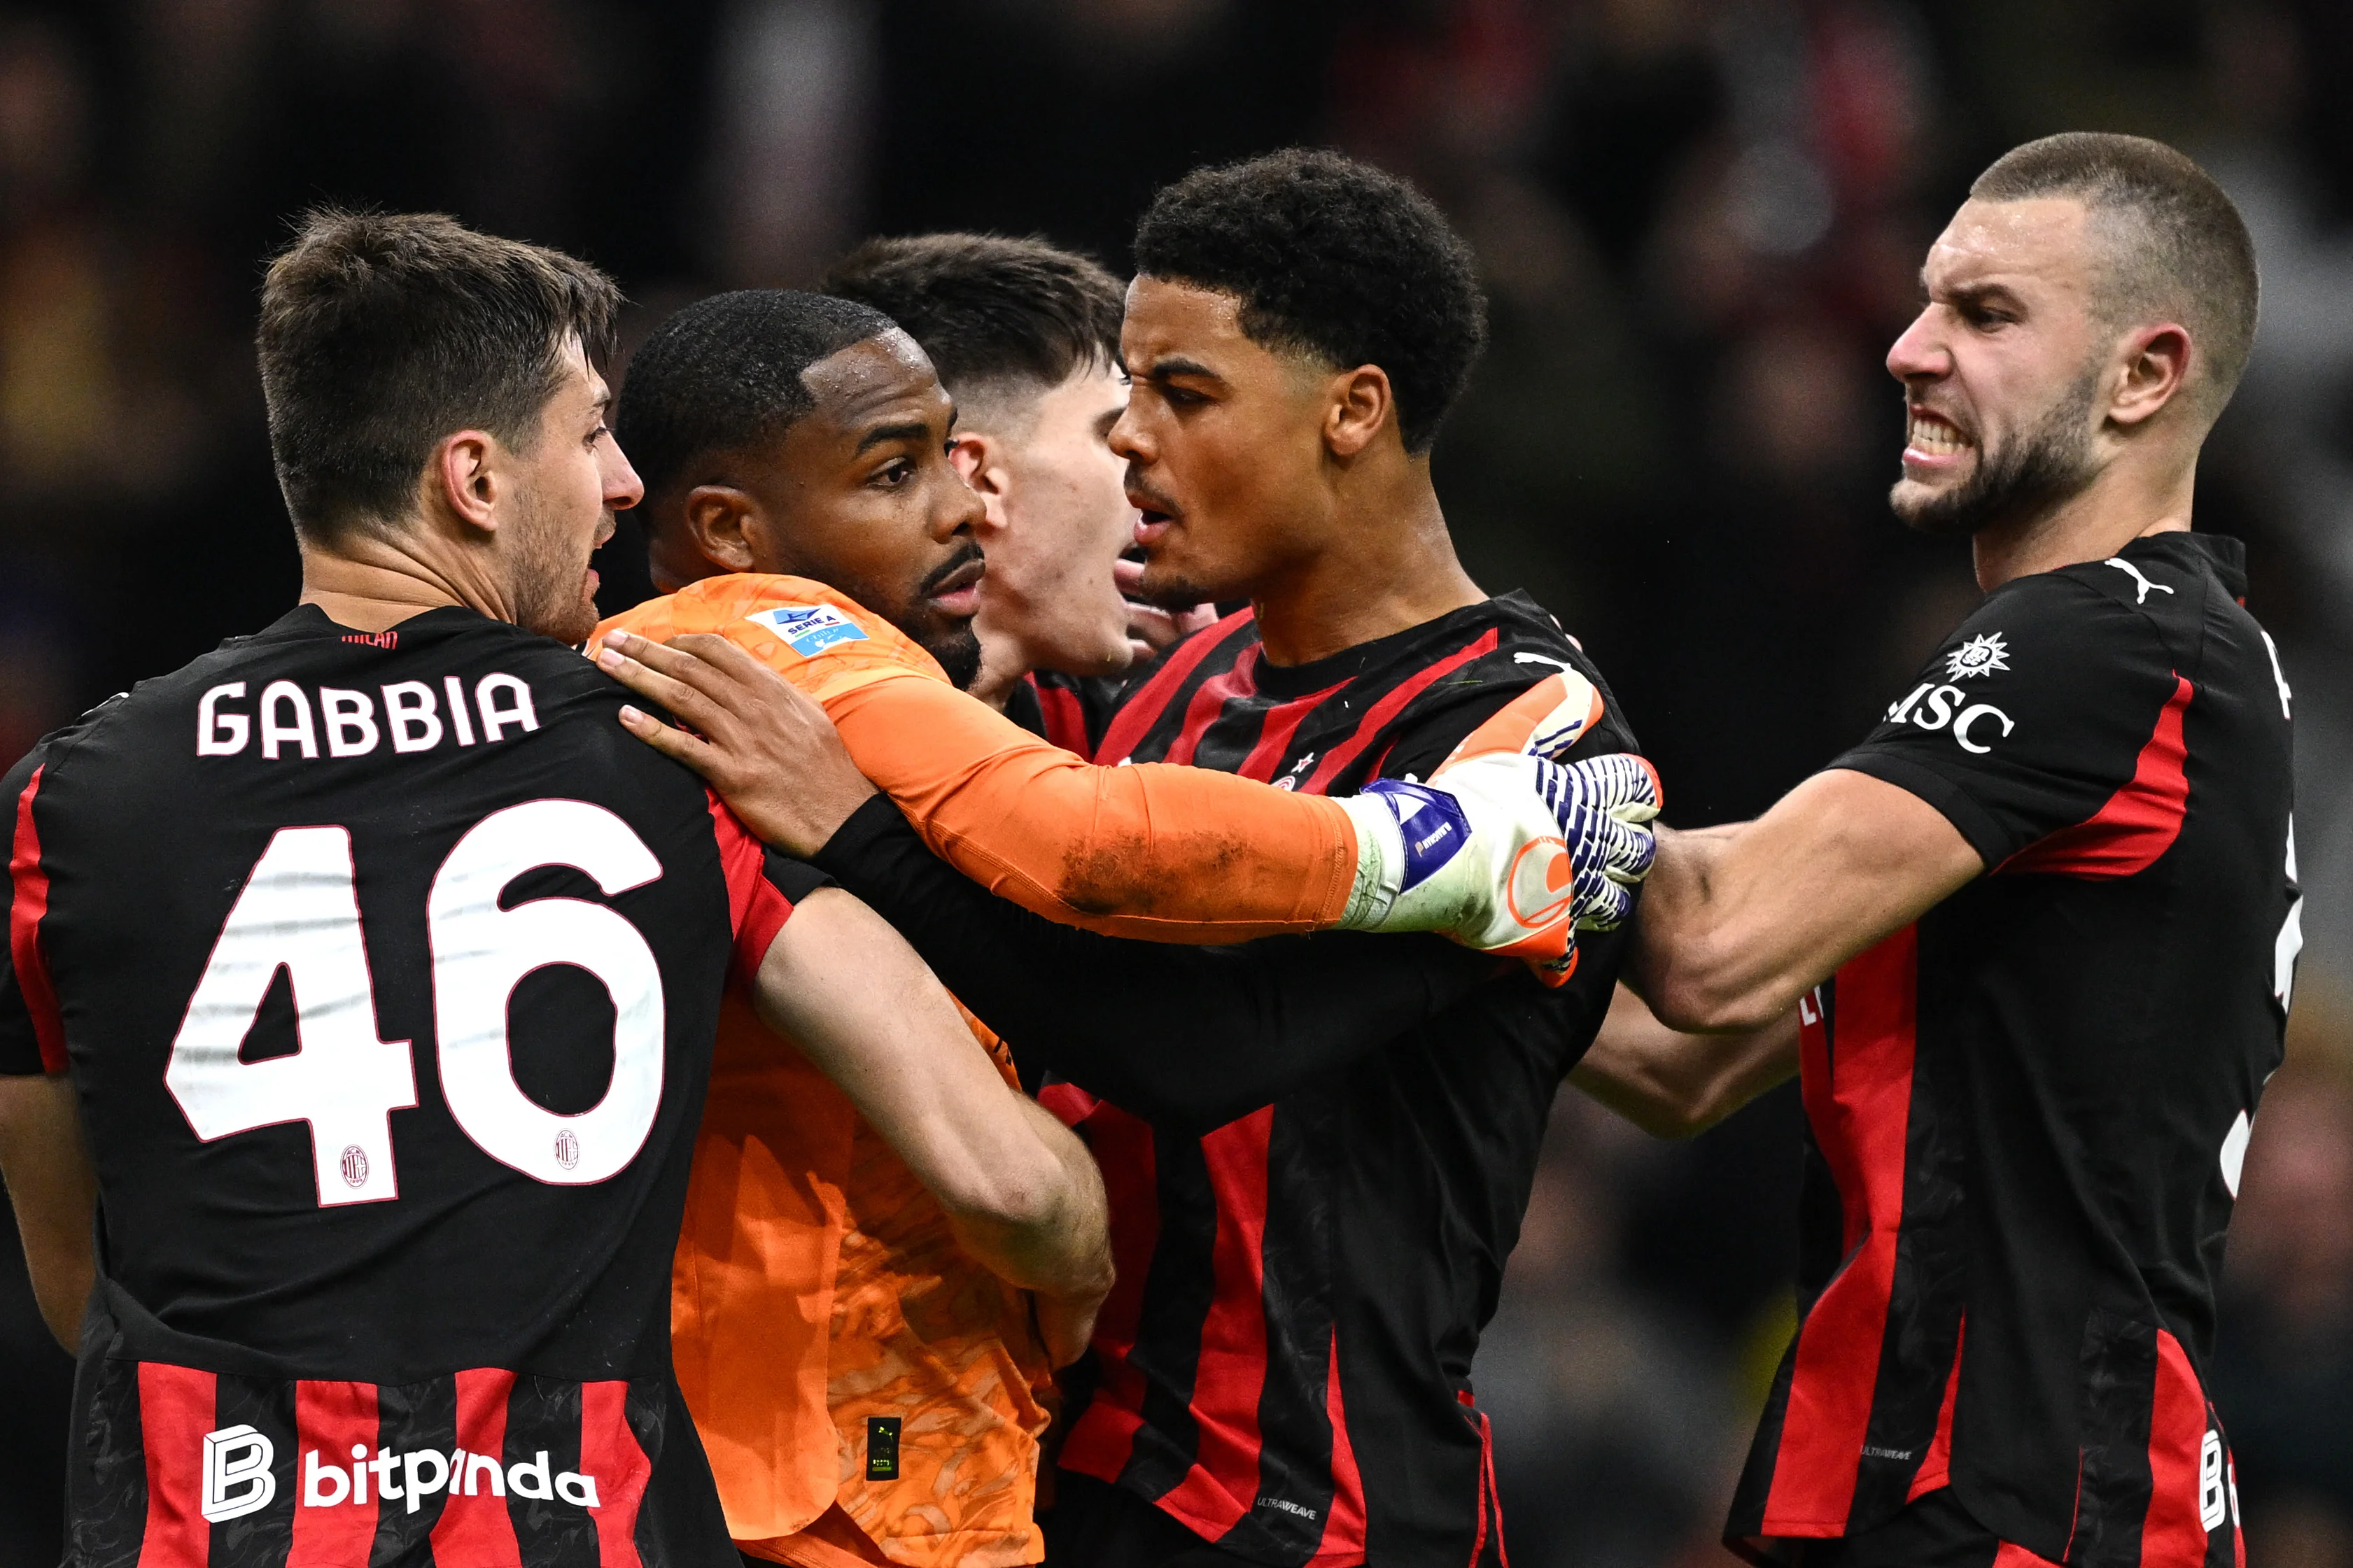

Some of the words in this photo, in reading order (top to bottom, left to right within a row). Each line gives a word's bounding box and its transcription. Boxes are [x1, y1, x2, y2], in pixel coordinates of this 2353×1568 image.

[788, 617, 824, 635] SERIE
[197, 672, 541, 760] GABBIA
[163, 798, 665, 1208] 46
[1257, 1497, 1316, 1520] ULTRAWEAVE
